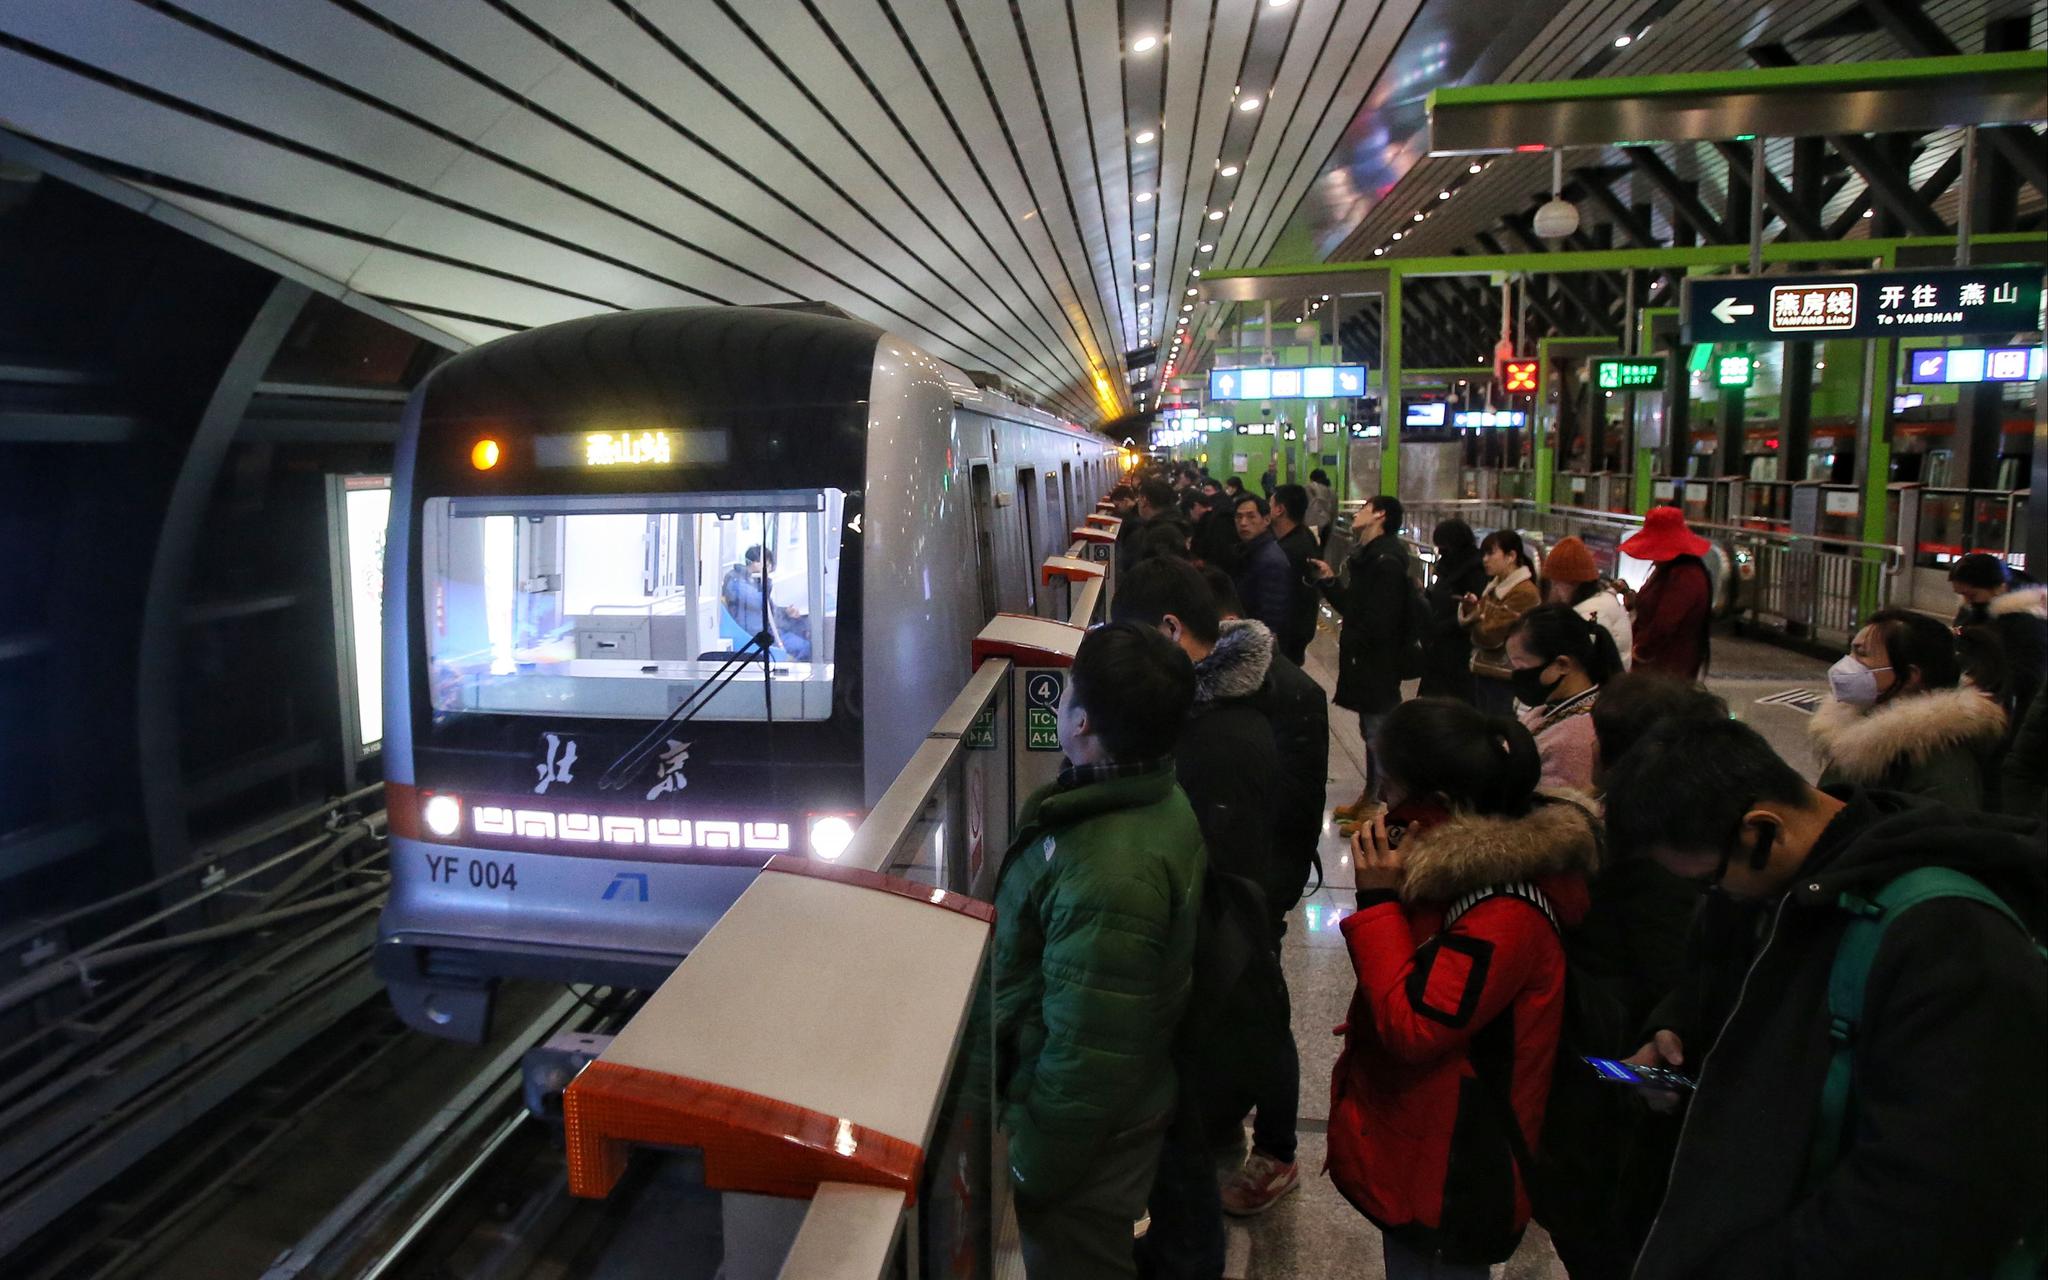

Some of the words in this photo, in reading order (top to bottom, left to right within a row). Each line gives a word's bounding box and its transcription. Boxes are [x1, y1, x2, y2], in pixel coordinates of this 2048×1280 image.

[1776, 291, 1852, 317] 燕房线
[1879, 284, 1938, 310] 开往
[1959, 282, 2019, 307] 燕山
[1775, 315, 1825, 326] YANFANG
[1826, 315, 1849, 325] Line
[1877, 314, 1894, 326] To
[1896, 312, 1963, 325] YANSHAN
[1038, 681, 1051, 699] 4
[1032, 732, 1058, 743] A14
[534, 732, 692, 801] 北京
[426, 853, 459, 883] YF
[469, 859, 518, 890] 004
